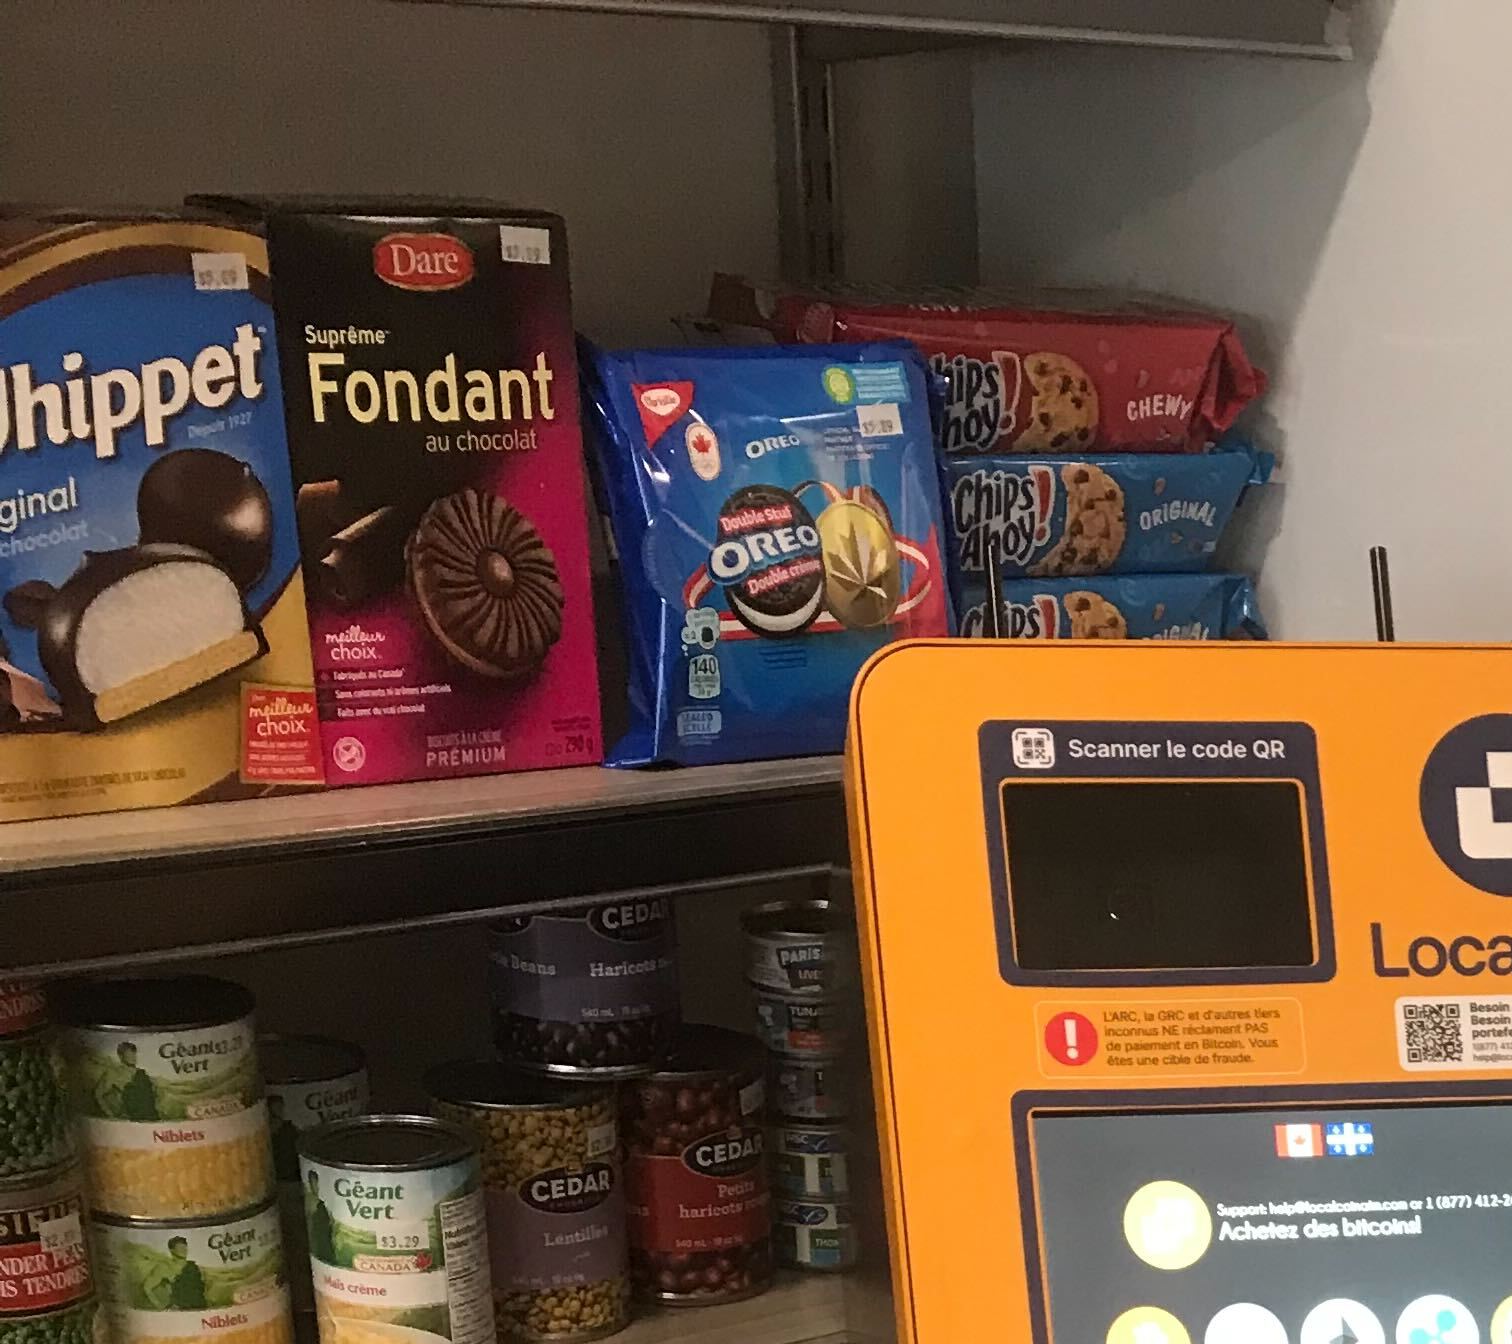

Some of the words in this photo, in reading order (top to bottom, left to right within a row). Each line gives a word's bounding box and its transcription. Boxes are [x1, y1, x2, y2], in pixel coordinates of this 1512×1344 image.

[389, 243, 459, 277] Dare
[304, 324, 387, 350] Suprême
[307, 351, 555, 424] Fondant
[1125, 392, 1194, 422] CHEWY
[425, 434, 450, 452] au
[456, 428, 538, 451] chocolat
[745, 433, 801, 460] OREO
[720, 508, 763, 533] Double
[764, 503, 793, 522] Stuf
[1139, 499, 1218, 532] ORIGINAL
[709, 524, 819, 578] OREO
[747, 570, 789, 596] Double
[330, 643, 379, 661] choix
[691, 657, 717, 676] 140
[257, 717, 308, 736] choix
[427, 745, 507, 768] PRÉMIUM
[1068, 739, 1161, 759] Scanner
[1167, 740, 1186, 759] le
[1191, 740, 1247, 759] code
[1252, 739, 1286, 760] QR
[510, 953, 557, 976] Beans
[589, 959, 657, 978] Haricots
[1144, 1011, 1155, 1022] la
[1157, 1010, 1185, 1022] GRC
[1187, 1011, 1200, 1021] et
[1254, 1007, 1281, 1019] tiers
[1469, 1002, 1511, 1013] Besoin
[1104, 1025, 1159, 1037] inconnus
[1162, 1025, 1181, 1036] NE
[1244, 1022, 1269, 1034] PAS
[1470, 1014, 1511, 1025] Besoin
[1105, 1040, 1122, 1052] de
[1124, 1040, 1181, 1054] paiement
[1183, 1040, 1199, 1051] en
[1247, 1036, 1279, 1049] Vous
[171, 1058, 209, 1075] Vert
[1106, 1053, 1134, 1066] êtes
[1136, 1055, 1159, 1066] une
[1162, 1052, 1191, 1065] cible
[1193, 1052, 1210, 1065] de
[153, 1129, 205, 1144] Niblets
[333, 1176, 405, 1201] Géant
[530, 1169, 611, 1203] CEDAR
[345, 1199, 395, 1220] Vert
[679, 1203, 744, 1219] haricots
[1216, 1202, 1268, 1219] Support:
[1409, 1200, 1423, 1211] or
[1425, 1196, 1434, 1210] 1
[1435, 1194, 1473, 1210] (877)
[207, 1228, 256, 1250] Géant
[1218, 1220, 1300, 1242] Achetez
[1302, 1218, 1340, 1239] des
[380, 1234, 420, 1250] $3.29
[218, 1245, 252, 1264] Vert
[359, 1261, 412, 1273] CANADA
[347, 1280, 388, 1298] crème
[201, 1313, 249, 1329] Niblets
